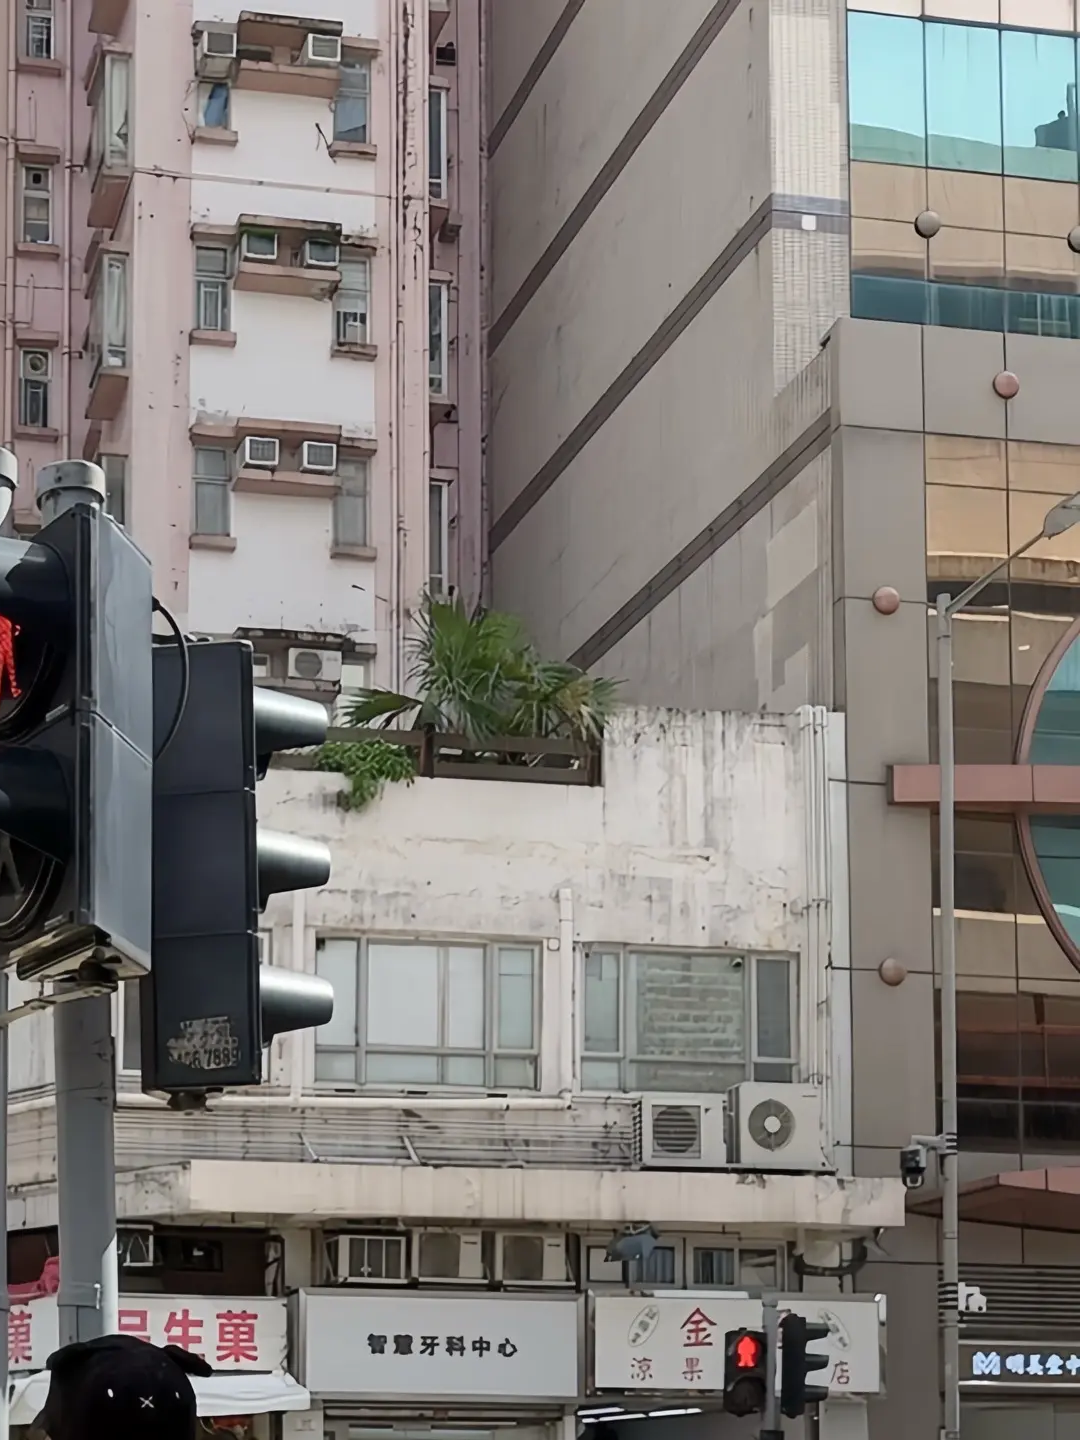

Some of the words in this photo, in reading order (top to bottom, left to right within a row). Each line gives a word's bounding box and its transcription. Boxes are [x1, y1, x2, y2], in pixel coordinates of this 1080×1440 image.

[367, 1333, 518, 1358] 智慧牙科中心
